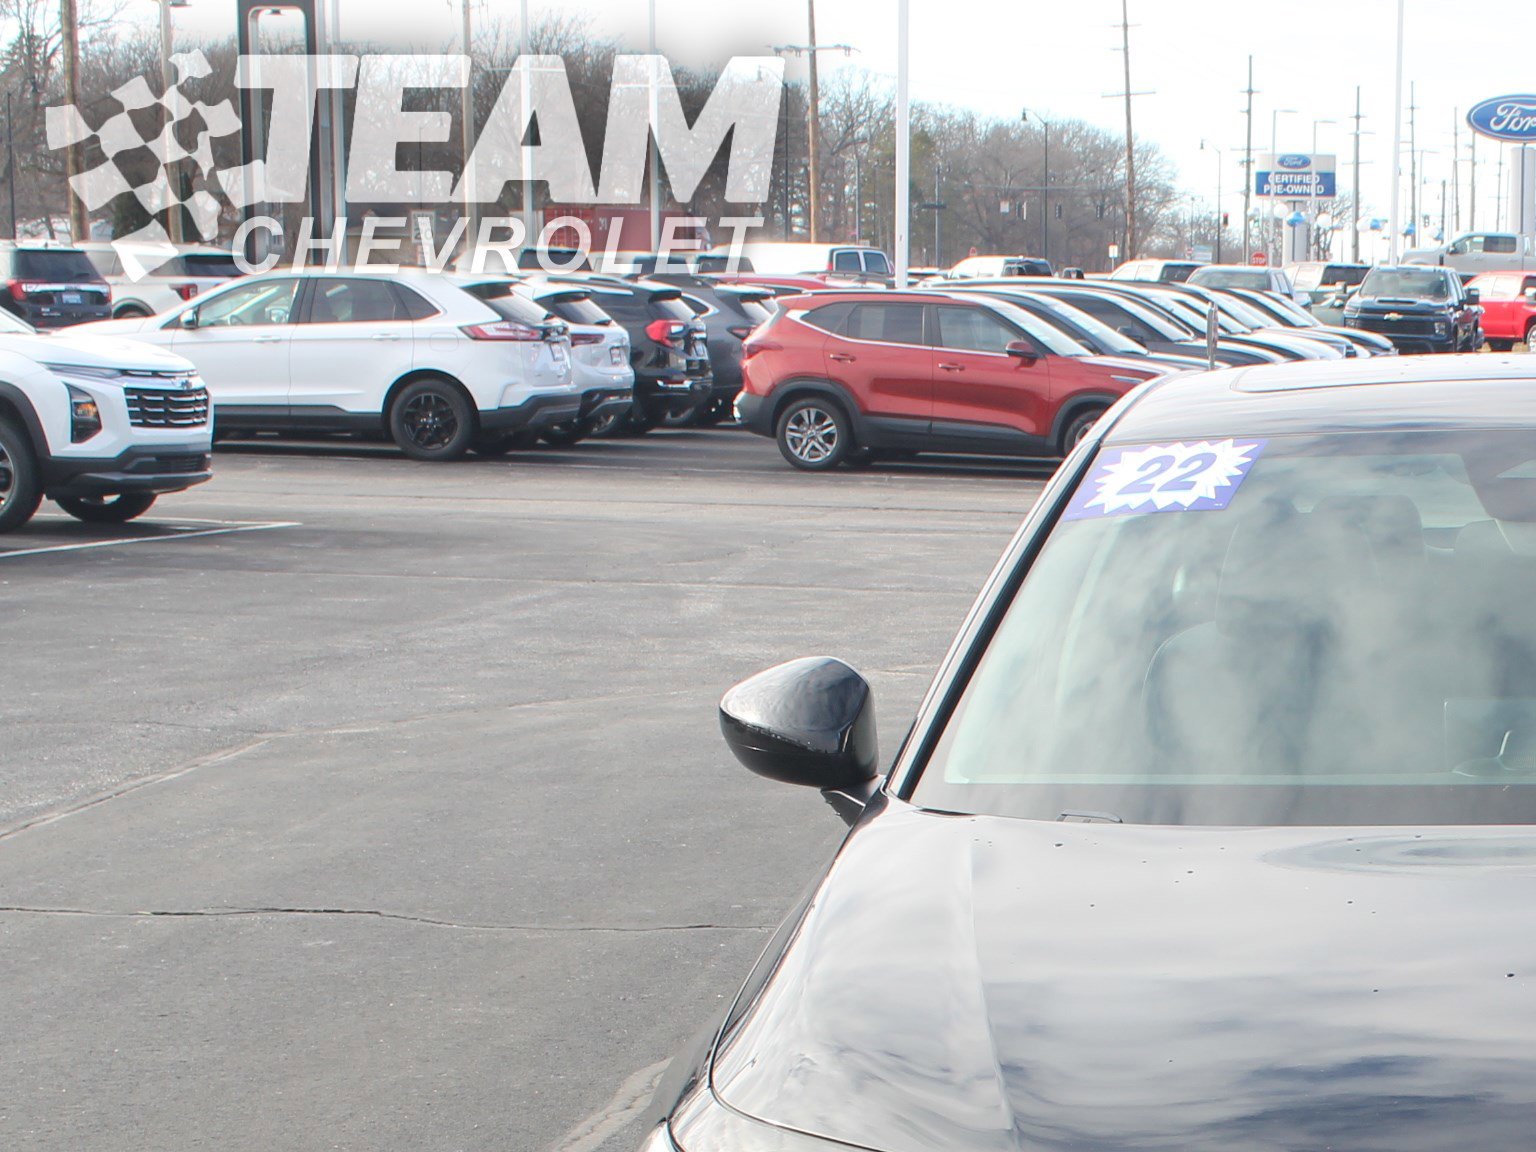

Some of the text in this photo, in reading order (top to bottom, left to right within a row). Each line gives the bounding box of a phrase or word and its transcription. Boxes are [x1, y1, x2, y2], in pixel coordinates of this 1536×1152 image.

[1284, 157, 1303, 166] Ford
[1268, 174, 1320, 184] CERTIFIED
[1263, 184, 1325, 194] PE-OWND
[1115, 452, 1218, 496] 22
